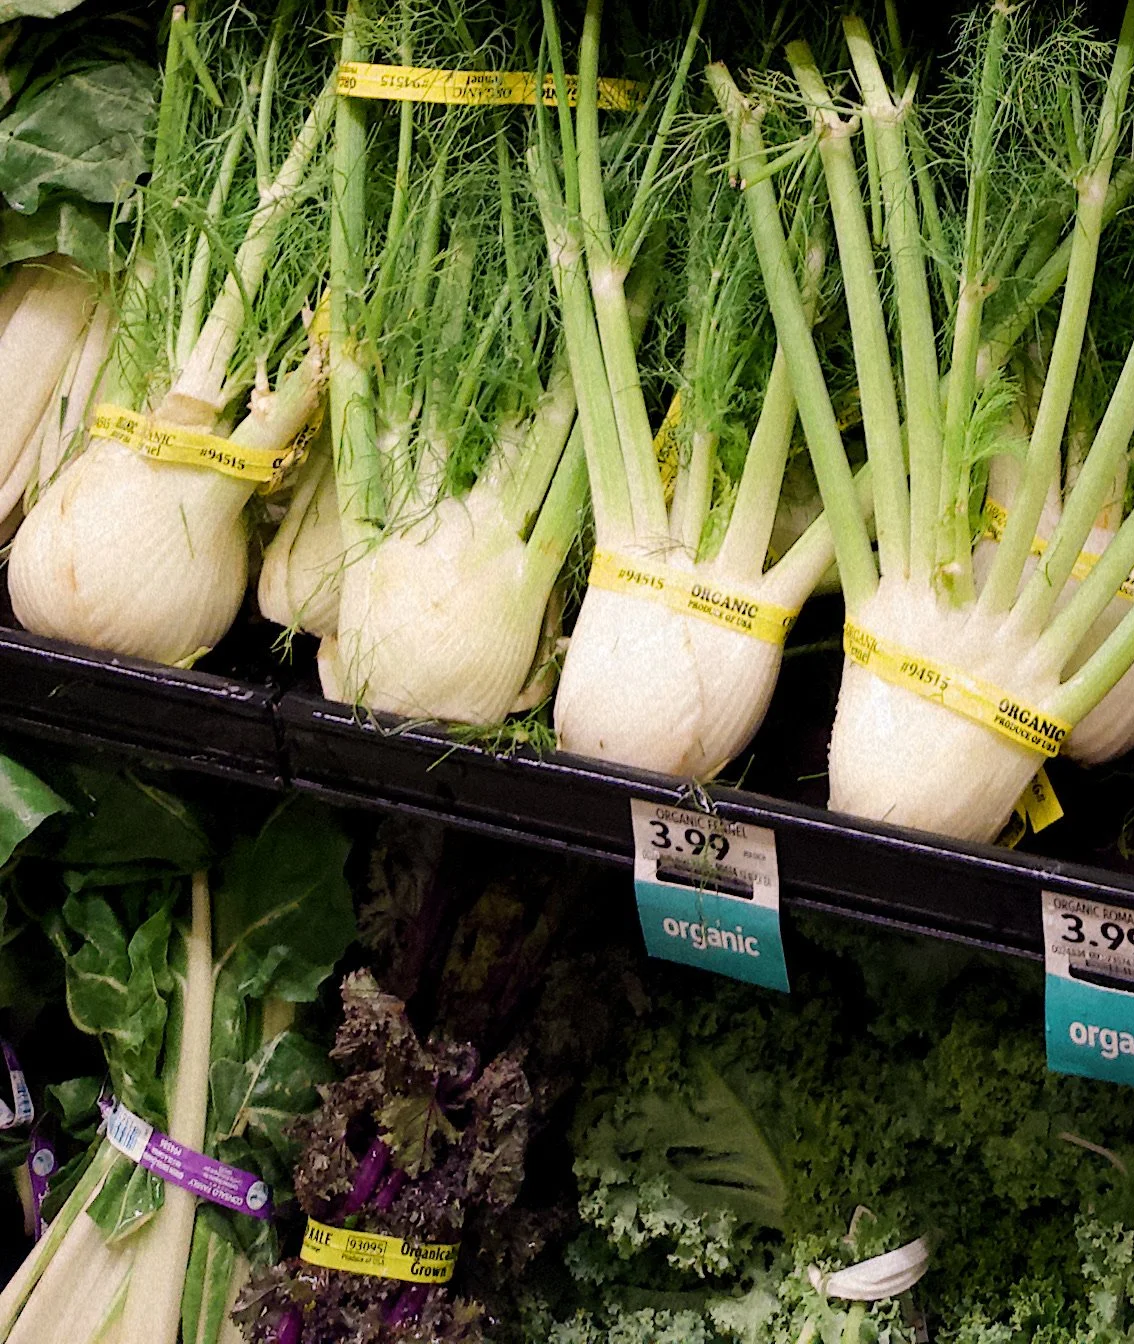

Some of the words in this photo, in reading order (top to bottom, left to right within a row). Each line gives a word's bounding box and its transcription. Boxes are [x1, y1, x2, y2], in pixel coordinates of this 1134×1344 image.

[452, 87, 512, 99] ORGANIC
[199, 447, 246, 471] #94515
[618, 568, 665, 590] #94515
[688, 599, 723, 620] PRODUCE
[691, 584, 759, 619] ORGANIC
[900, 661, 949, 691] #94515
[994, 716, 1029, 741] PRODUCE
[998, 698, 1065, 742] ORGANIC
[656, 807, 705, 830] ORGANIC
[650, 820, 729, 861] 3.99
[1053, 897, 1098, 920] ORGANIC
[663, 917, 760, 957] organic
[308, 1230, 332, 1245] KALE
[401, 1241, 456, 1261] Organical
[411, 1261, 447, 1278] Grown
